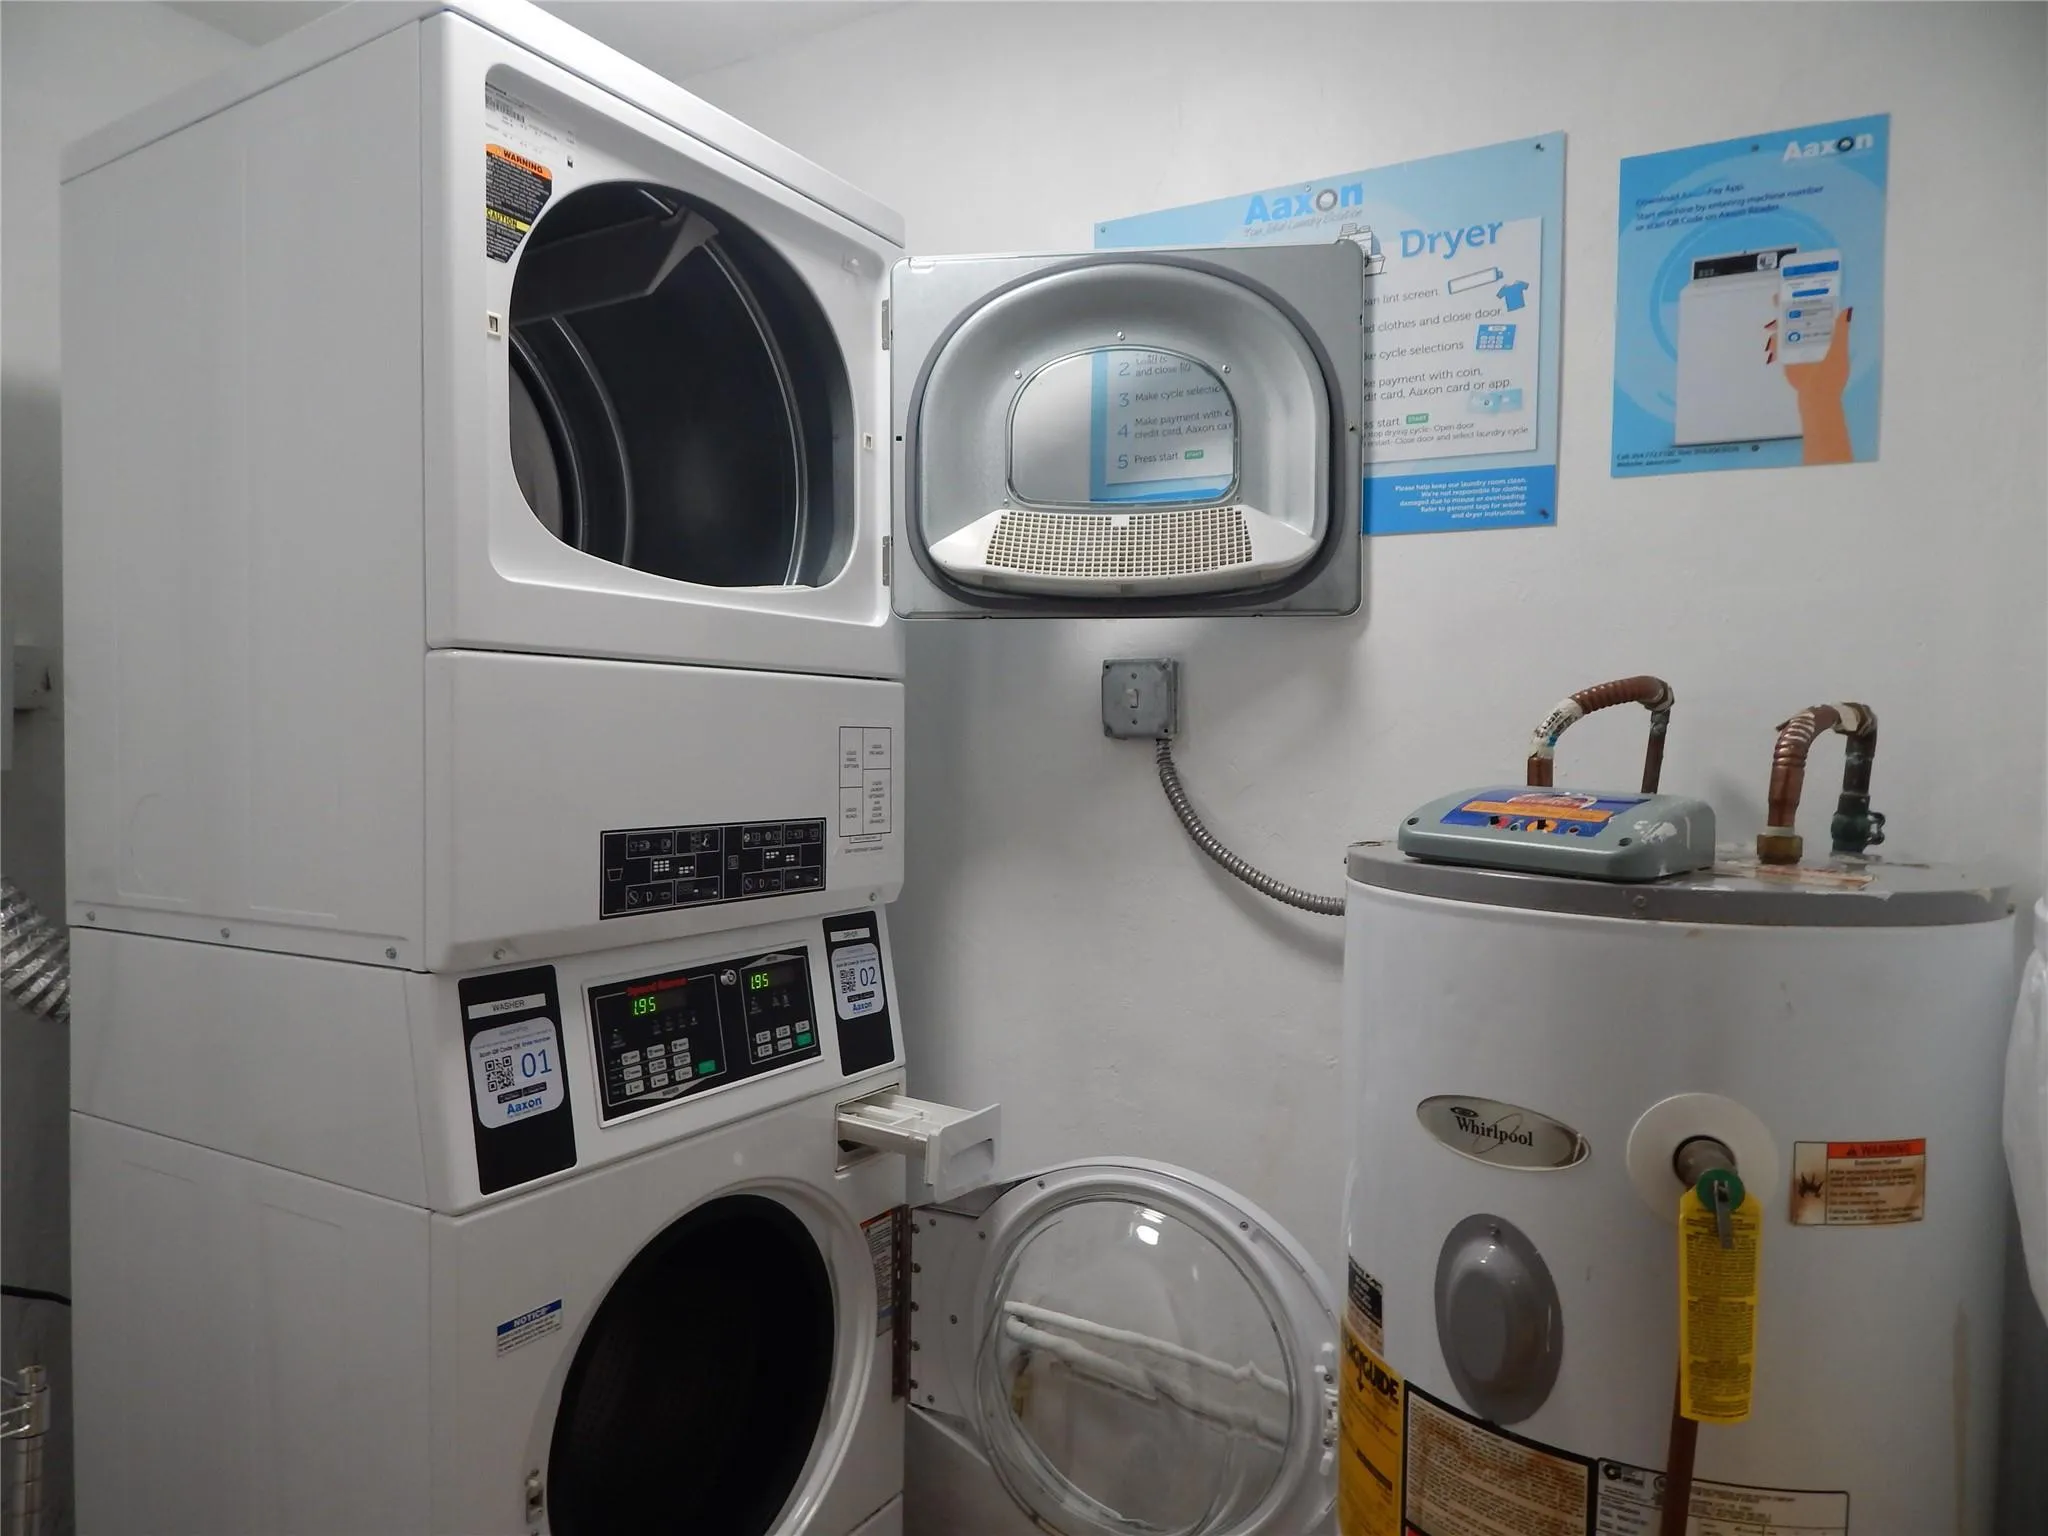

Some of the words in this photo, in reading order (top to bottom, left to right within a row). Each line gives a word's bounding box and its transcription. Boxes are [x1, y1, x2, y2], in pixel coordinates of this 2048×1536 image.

[1783, 131, 1873, 162] Aaxon
[503, 150, 543, 174] WARNING
[1244, 181, 1363, 225] Aaxon
[487, 208, 518, 228] CAUTION
[1400, 220, 1503, 261] Dryer
[1383, 293, 1400, 304] lint
[1378, 318, 1416, 332] clothes
[1419, 315, 1440, 327] and
[1443, 312, 1472, 325] close
[1379, 347, 1407, 361] cycle
[1410, 341, 1464, 356] selections
[1119, 361, 1131, 377] 2
[1378, 371, 1426, 388] payment
[1429, 368, 1453, 381] with
[1119, 392, 1130, 408] 3
[1135, 392, 1158, 402] Make
[1161, 388, 1184, 401] cycle
[1380, 388, 1406, 401] card,
[1408, 385, 1443, 397] Aaxon
[1446, 381, 1470, 393] card
[1473, 382, 1486, 391] or
[1117, 424, 1130, 438] 4
[1135, 416, 1158, 427] Make
[1160, 412, 1201, 427] payment
[1202, 408, 1222, 420] with
[1185, 424, 1215, 434] Aaxon
[1433, 422, 1454, 432] Open
[1437, 432, 1450, 441] and
[1118, 454, 1129, 469] 5
[1135, 454, 1157, 464] Press
[1452, 488, 1490, 496] responsible
[1461, 479, 1486, 488] laundry
[1400, 499, 1429, 507] damaged
[860, 966, 877, 987] 02
[492, 999, 525, 1013] WASHER
[521, 1048, 552, 1078] 01
[507, 1096, 542, 1114] Aaxon
[1456, 1115, 1533, 1147] Whirlpool
[513, 1307, 548, 1327] NOTICE
